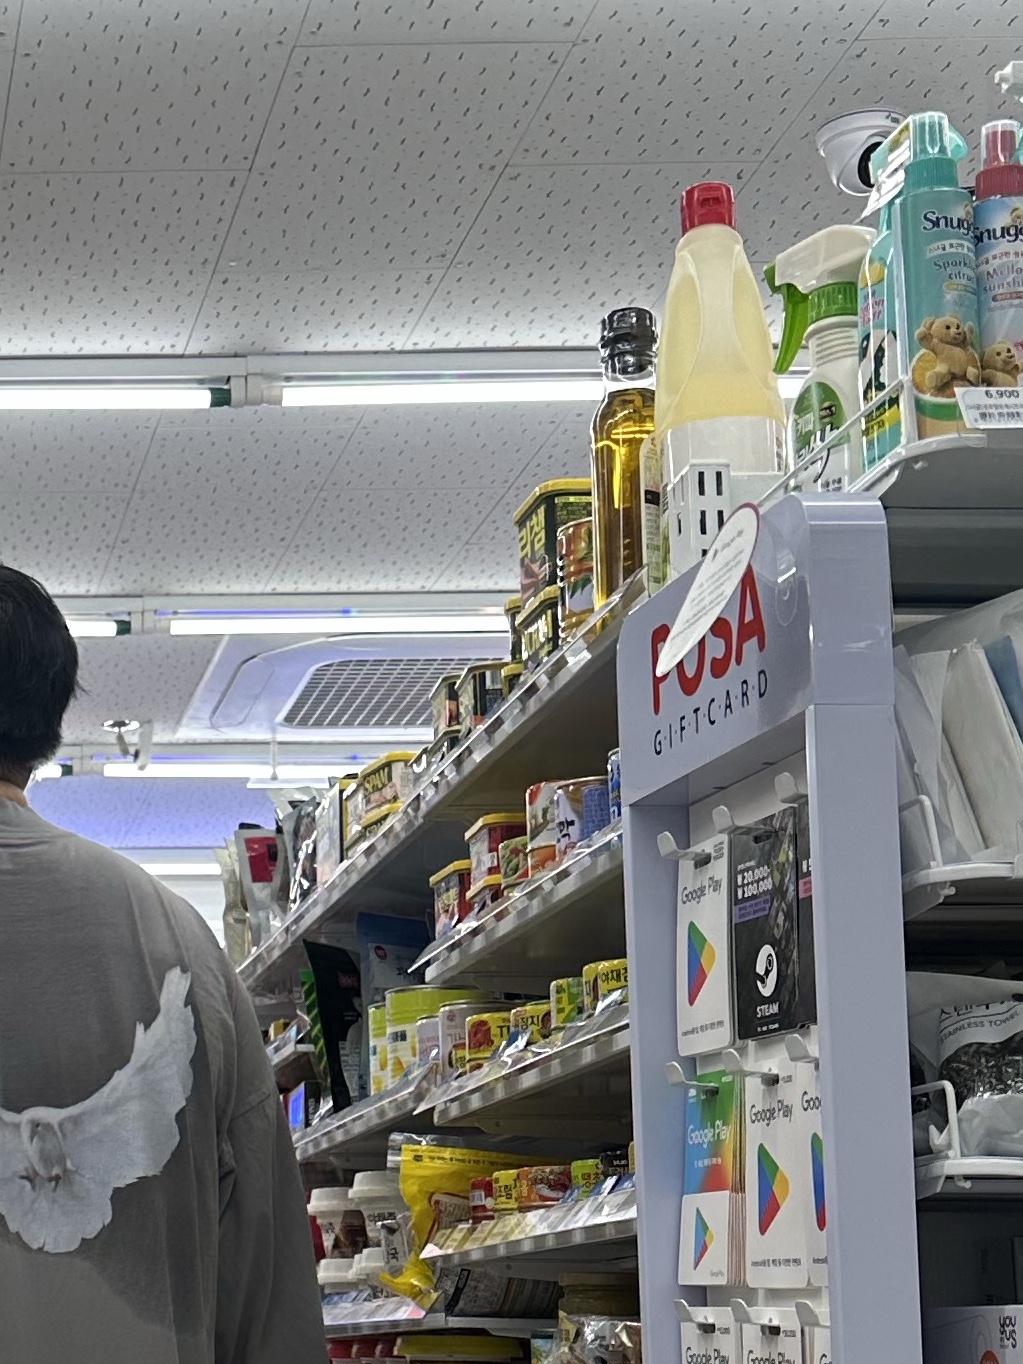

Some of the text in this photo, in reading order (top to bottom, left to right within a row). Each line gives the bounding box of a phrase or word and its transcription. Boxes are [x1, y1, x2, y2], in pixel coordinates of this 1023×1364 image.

[364, 766, 389, 794] SPAM
[681, 875, 723, 905] Google Play
[756, 1000, 780, 1018] STEAM
[749, 1099, 794, 1127] Google Play
[688, 1119, 731, 1149] Google Play
